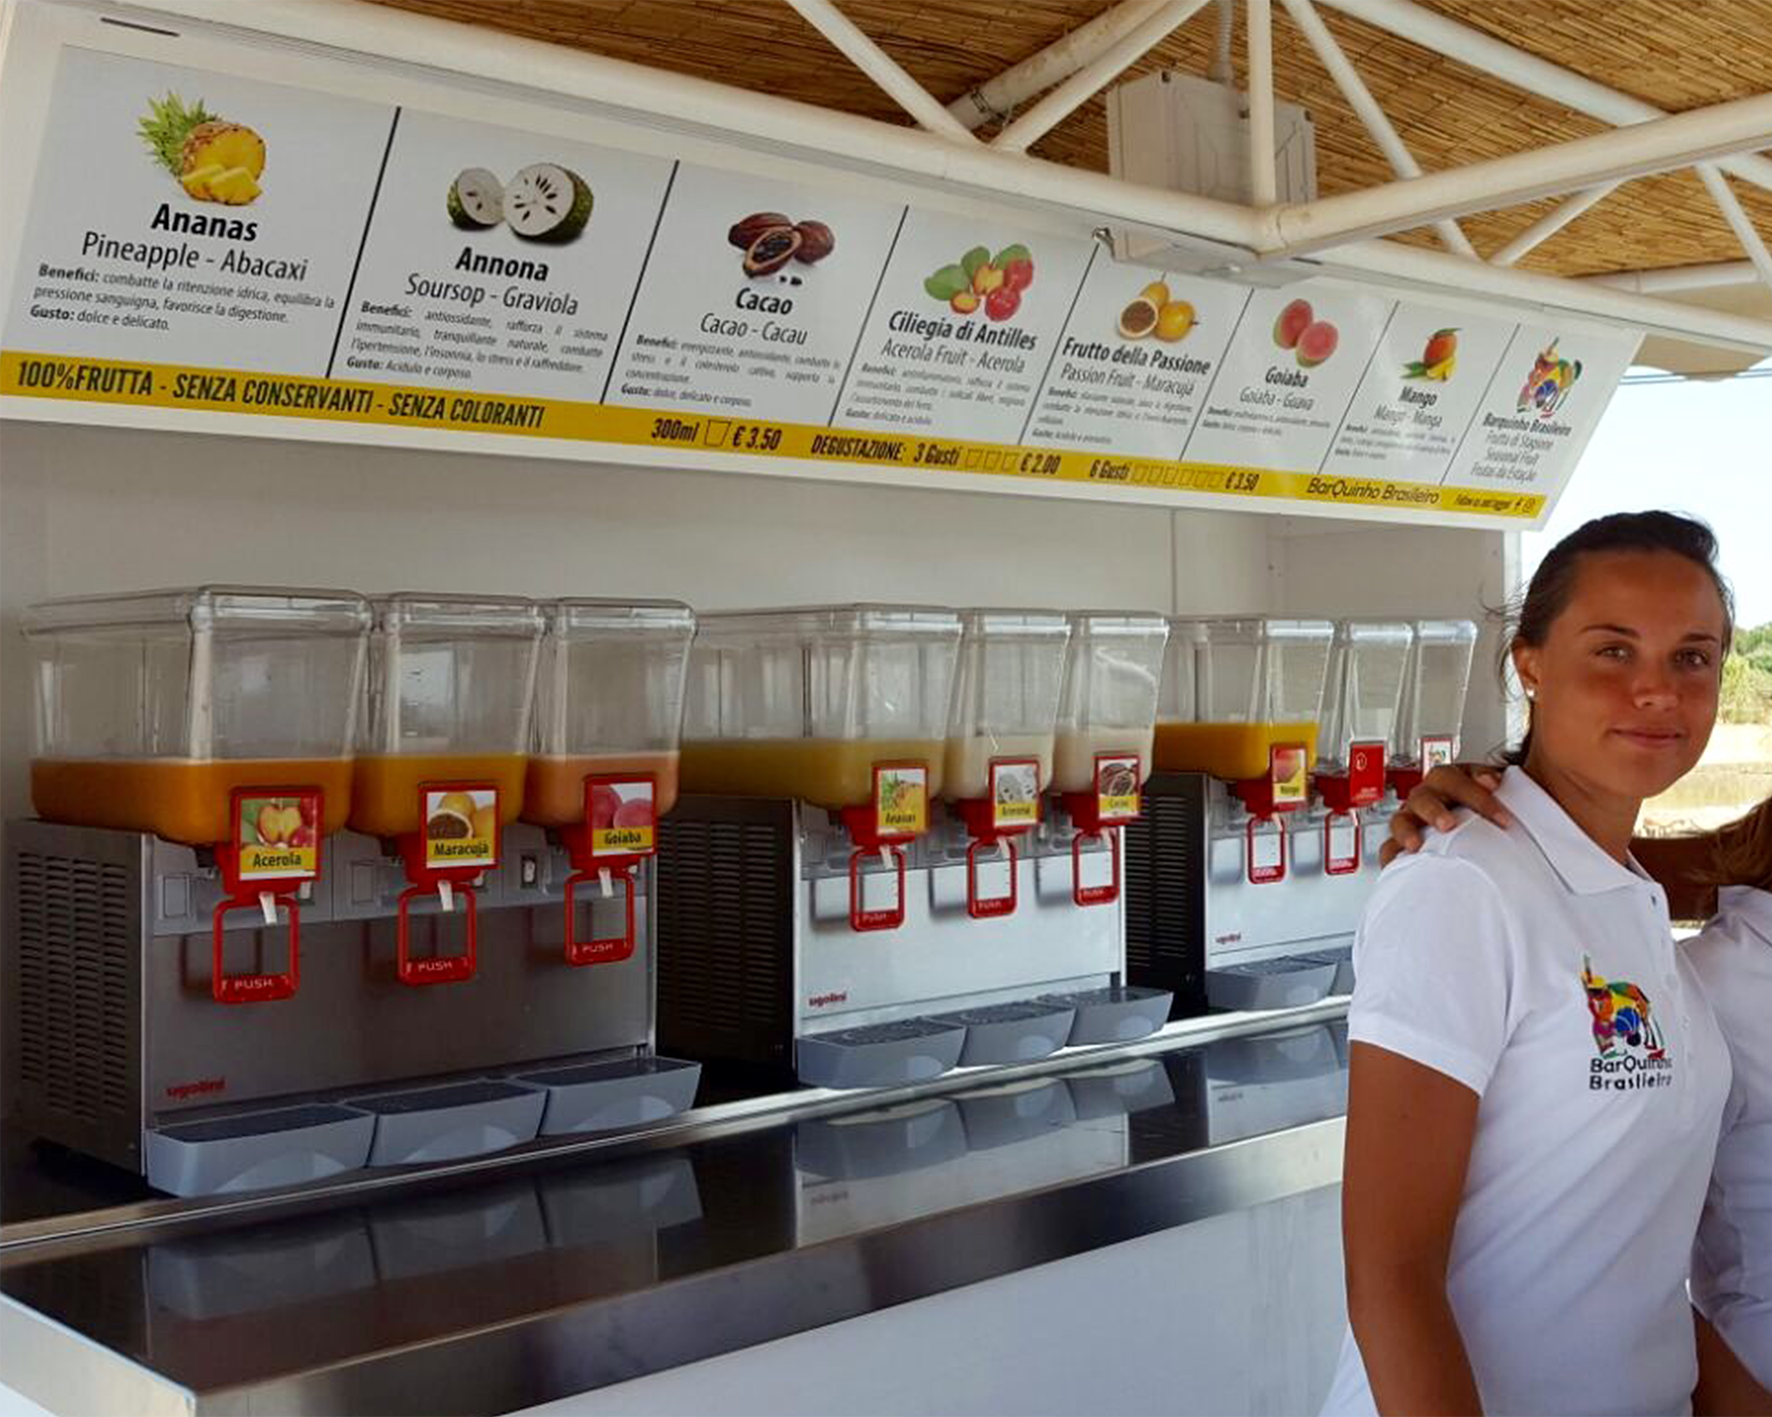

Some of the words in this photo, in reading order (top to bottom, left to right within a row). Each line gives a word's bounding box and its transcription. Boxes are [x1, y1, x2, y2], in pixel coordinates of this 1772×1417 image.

[151, 203, 258, 242] Ananas
[81, 231, 199, 271] Pineapple
[221, 249, 309, 281] Abacaxi
[455, 247, 549, 281] Annona
[38, 263, 100, 283] Benefici:
[102, 272, 159, 289] combatte
[163, 277, 173, 290] la
[177, 279, 234, 298] ritenzione
[237, 284, 270, 302] idrica,
[325, 296, 335, 309] la
[404, 273, 485, 308] Soursop
[502, 286, 579, 315] Graviola
[33, 286, 93, 302] pressione
[95, 291, 159, 311] sanguigna,
[163, 298, 213, 315] favorisce
[215, 303, 225, 315] la
[228, 304, 289, 324] digestione.
[361, 301, 413, 319] Benefici:
[735, 287, 793, 315] Cacao
[29, 304, 75, 321] Gusto:
[77, 310, 109, 324] dolce
[112, 314, 119, 324] e
[121, 314, 170, 331] delicato.
[700, 313, 748, 337] Cacao
[762, 321, 808, 346] Cacau
[889, 310, 952, 341] Ciliegia
[955, 320, 976, 341] di
[974, 324, 1038, 351] Antilles
[347, 356, 383, 371] Gusto:
[386, 360, 422, 374] Acidulo
[424, 366, 431, 375] e
[881, 338, 932, 363] Acerola
[935, 346, 967, 366] Fruit
[976, 352, 1025, 373] Acerola
[1062, 337, 1110, 362] Frutto
[1111, 344, 1148, 366] della
[1150, 349, 1211, 375] Passione
[1060, 362, 1106, 385] Passion
[1106, 368, 1135, 388] Fruit
[1265, 366, 1309, 388] Goiaba
[18, 360, 154, 396] 100%FRUTTA
[173, 373, 236, 403] SENZA
[242, 379, 373, 415] CONSERVANTI
[388, 393, 445, 422] SENZA
[449, 398, 544, 429] COLORANTI
[1240, 386, 1277, 406] Goiaba
[1398, 386, 1438, 409] Mango
[651, 418, 700, 443] 300ml
[732, 425, 746, 447] €
[746, 427, 783, 450] 3.50
[1482, 412, 1530, 431] Barquinho
[1530, 418, 1572, 437] Brasileiro
[810, 434, 906, 462] DEGUSTAZIONE:
[913, 442, 924, 463] 3
[924, 444, 962, 466] Gusti
[1020, 452, 1032, 472] €
[1032, 455, 1061, 475] 2.00
[1090, 459, 1099, 477] 6
[1099, 459, 1131, 481] Gusti
[1225, 471, 1236, 489] €
[1235, 473, 1259, 491] 3.50
[1306, 477, 1380, 499] BarQuinho
[1381, 485, 1440, 505] Brasileiro
[604, 831, 641, 845] Goiaba
[253, 852, 301, 868] Acerola
[582, 942, 614, 954] PUSH
[417, 960, 453, 973] PUSH
[234, 978, 274, 990] PUSH
[808, 992, 847, 1007] ugolini
[1589, 1072, 1672, 1090] Brasileiro
